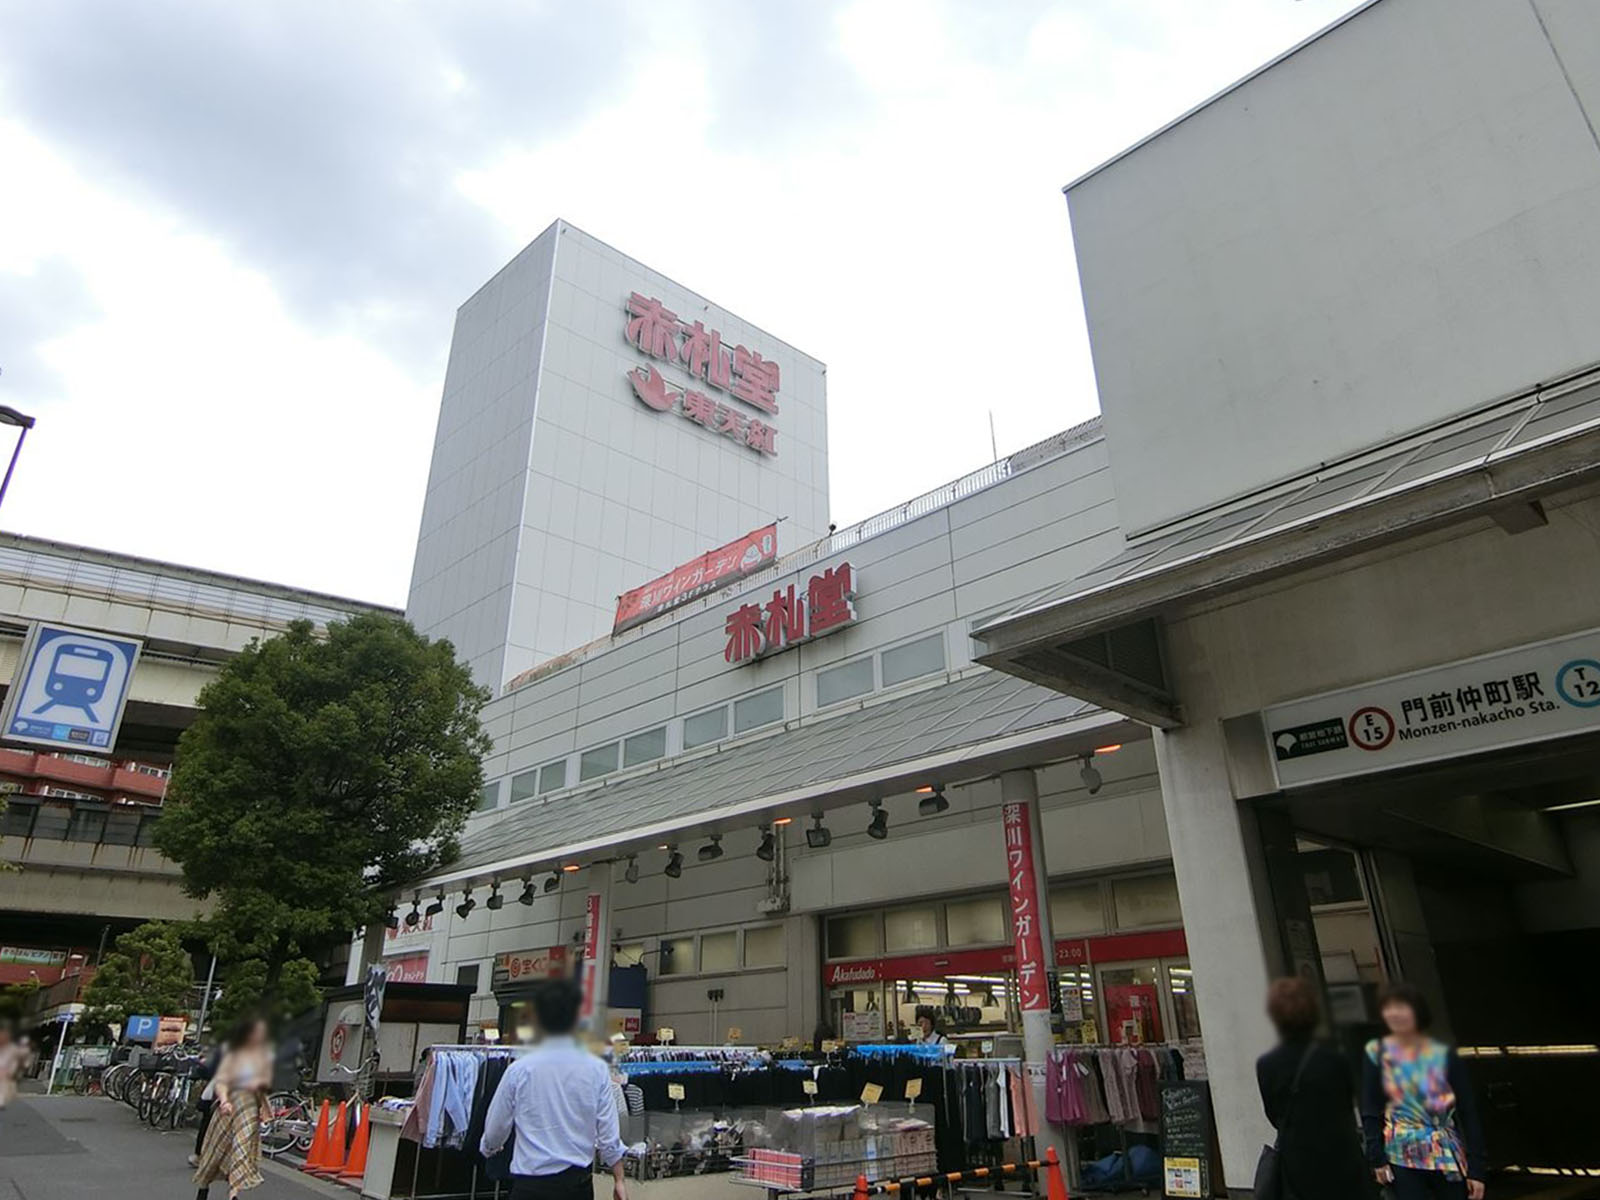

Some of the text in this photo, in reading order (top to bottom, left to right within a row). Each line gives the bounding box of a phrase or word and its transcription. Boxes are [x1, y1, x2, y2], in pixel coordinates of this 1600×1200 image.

[625, 291, 779, 416] 赤札堂
[682, 387, 779, 457] 東天紅
[724, 561, 857, 663] 赤札堂
[1574, 667, 1586, 681] T
[1400, 671, 1545, 726] 門前仲町駅
[1573, 682, 1600, 698] 12
[1363, 727, 1385, 742] 15
[1365, 714, 1375, 727] E
[1399, 698, 1561, 742] Monzen-nakacho Sta.
[137, 1019, 152, 1035] P
